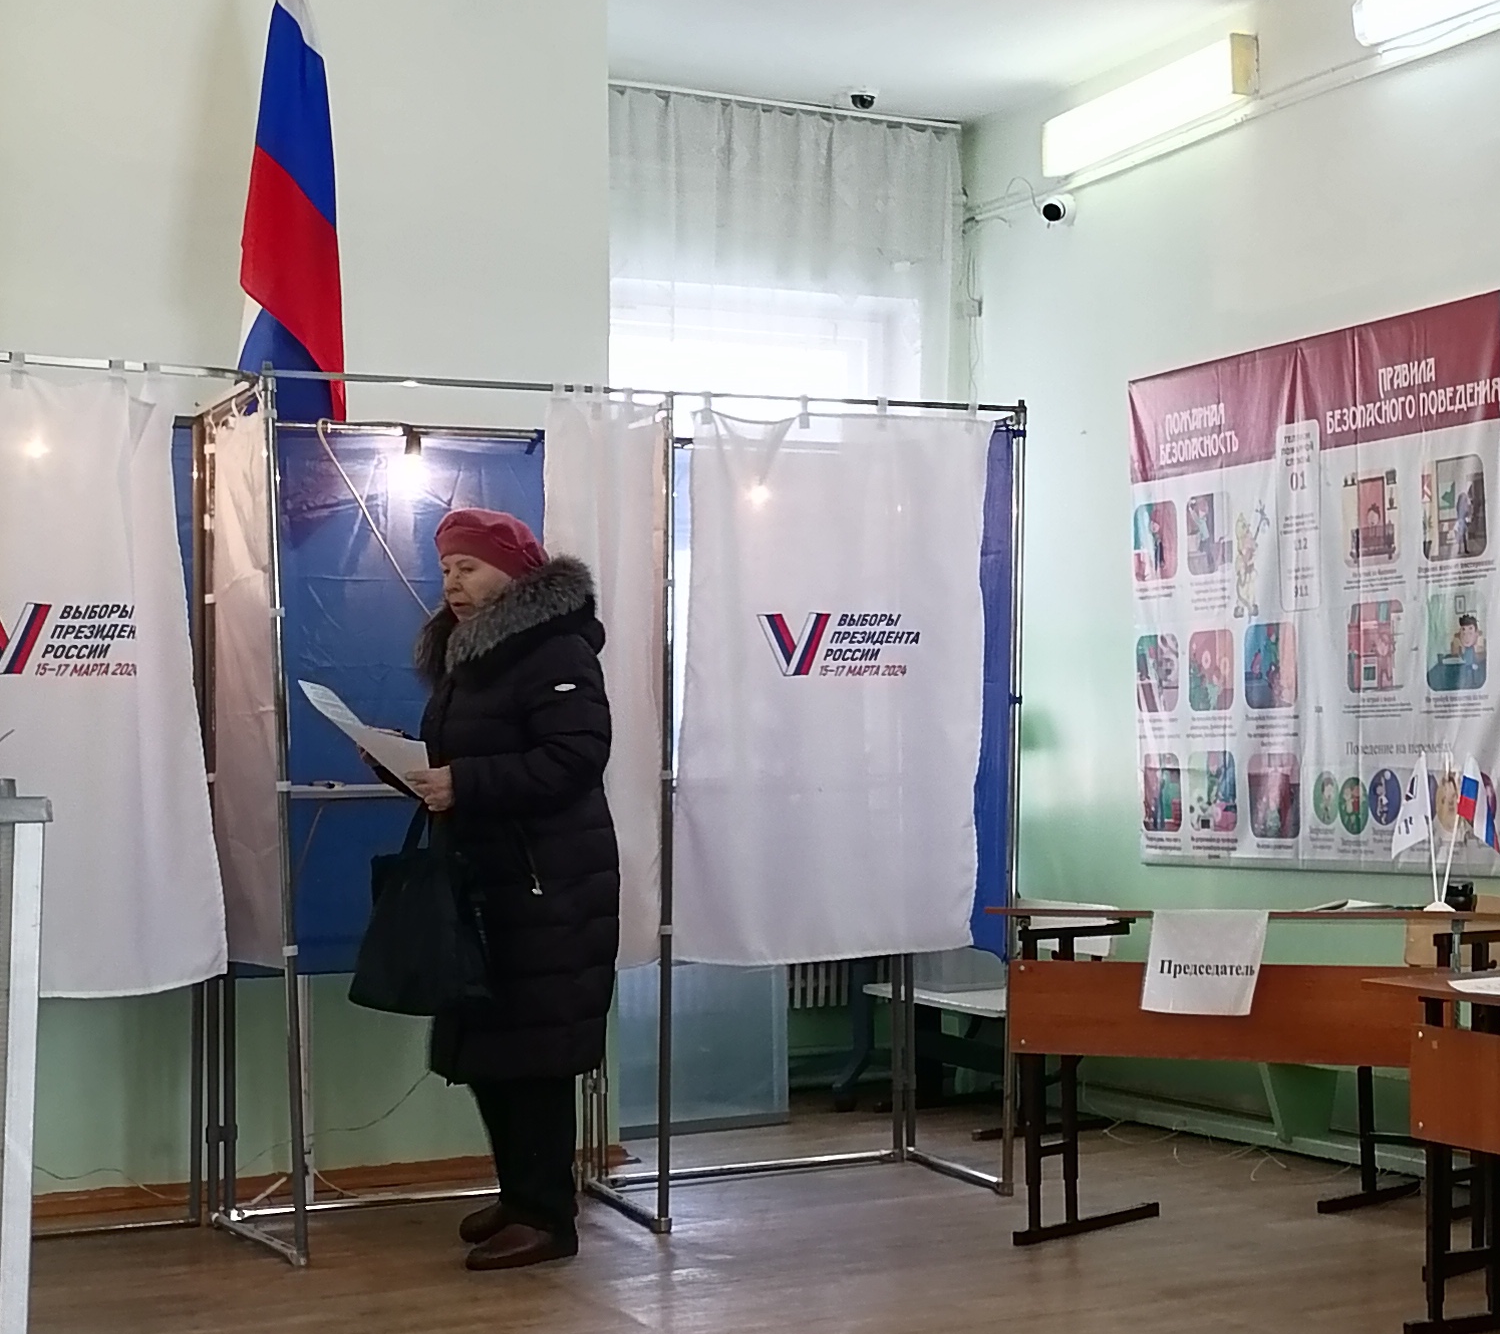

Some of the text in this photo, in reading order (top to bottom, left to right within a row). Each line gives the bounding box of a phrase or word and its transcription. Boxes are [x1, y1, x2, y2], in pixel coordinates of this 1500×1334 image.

[1378, 357, 1435, 398] ПРАВИЛА
[1165, 402, 1226, 441] ПОЖАРНАЯ
[1326, 394, 1415, 434] БЕЗОПАСНОГО
[1159, 430, 1239, 465] БЕЗОПАСНОСТЬ
[1290, 471, 1307, 491] 01
[59, 604, 136, 620] ВЫБОРЫ
[837, 613, 902, 627] ВЫБОРЫ
[829, 631, 921, 646] ПРЕЗИДЕНТА
[41, 643, 111, 659] РОССИИ
[823, 648, 881, 661] РОССИИ
[70, 663, 110, 677] МАРТА
[846, 665, 881, 676] МАРТА
[881, 665, 907, 676] 2024
[1396, 743, 1407, 754] на
[1160, 959, 1255, 978] Председатель
